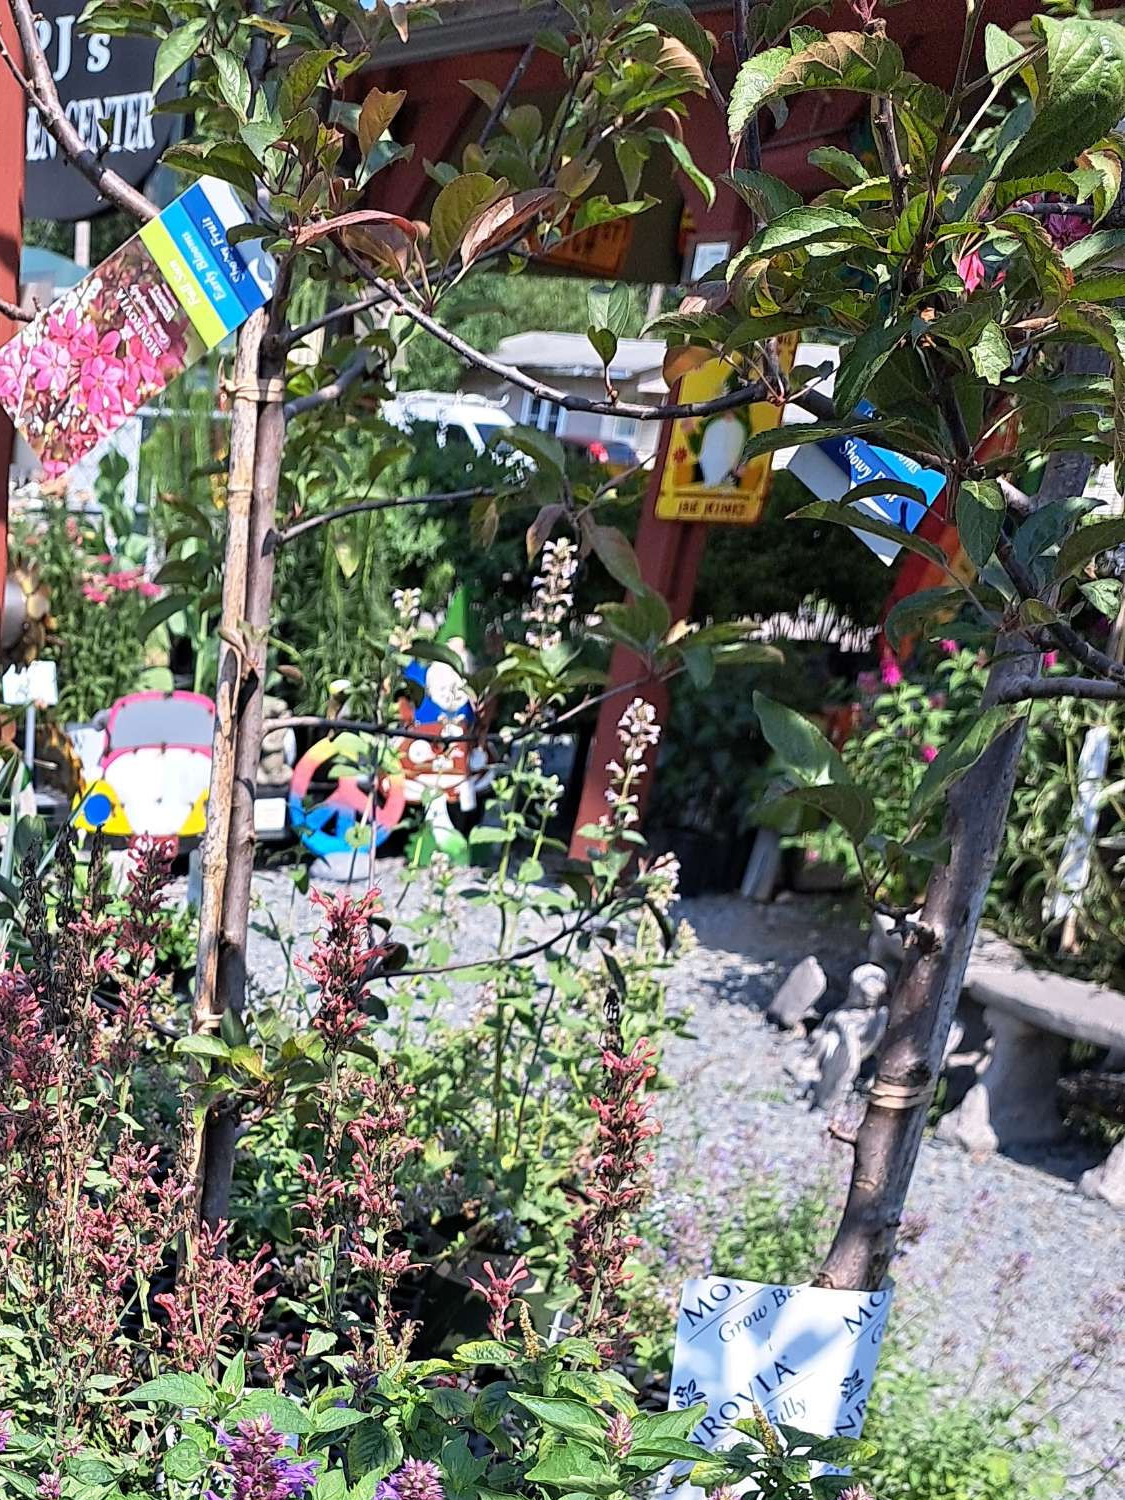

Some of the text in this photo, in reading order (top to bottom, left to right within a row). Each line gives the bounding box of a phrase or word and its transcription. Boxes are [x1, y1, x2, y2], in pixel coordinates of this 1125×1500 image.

[201, 216, 224, 248] Fruit
[180, 231, 227, 302] Early Blooms
[116, 287, 162, 358] MONROVIA
[838, 440, 873, 480] Showy
[718, 1306, 768, 1343] Grow
